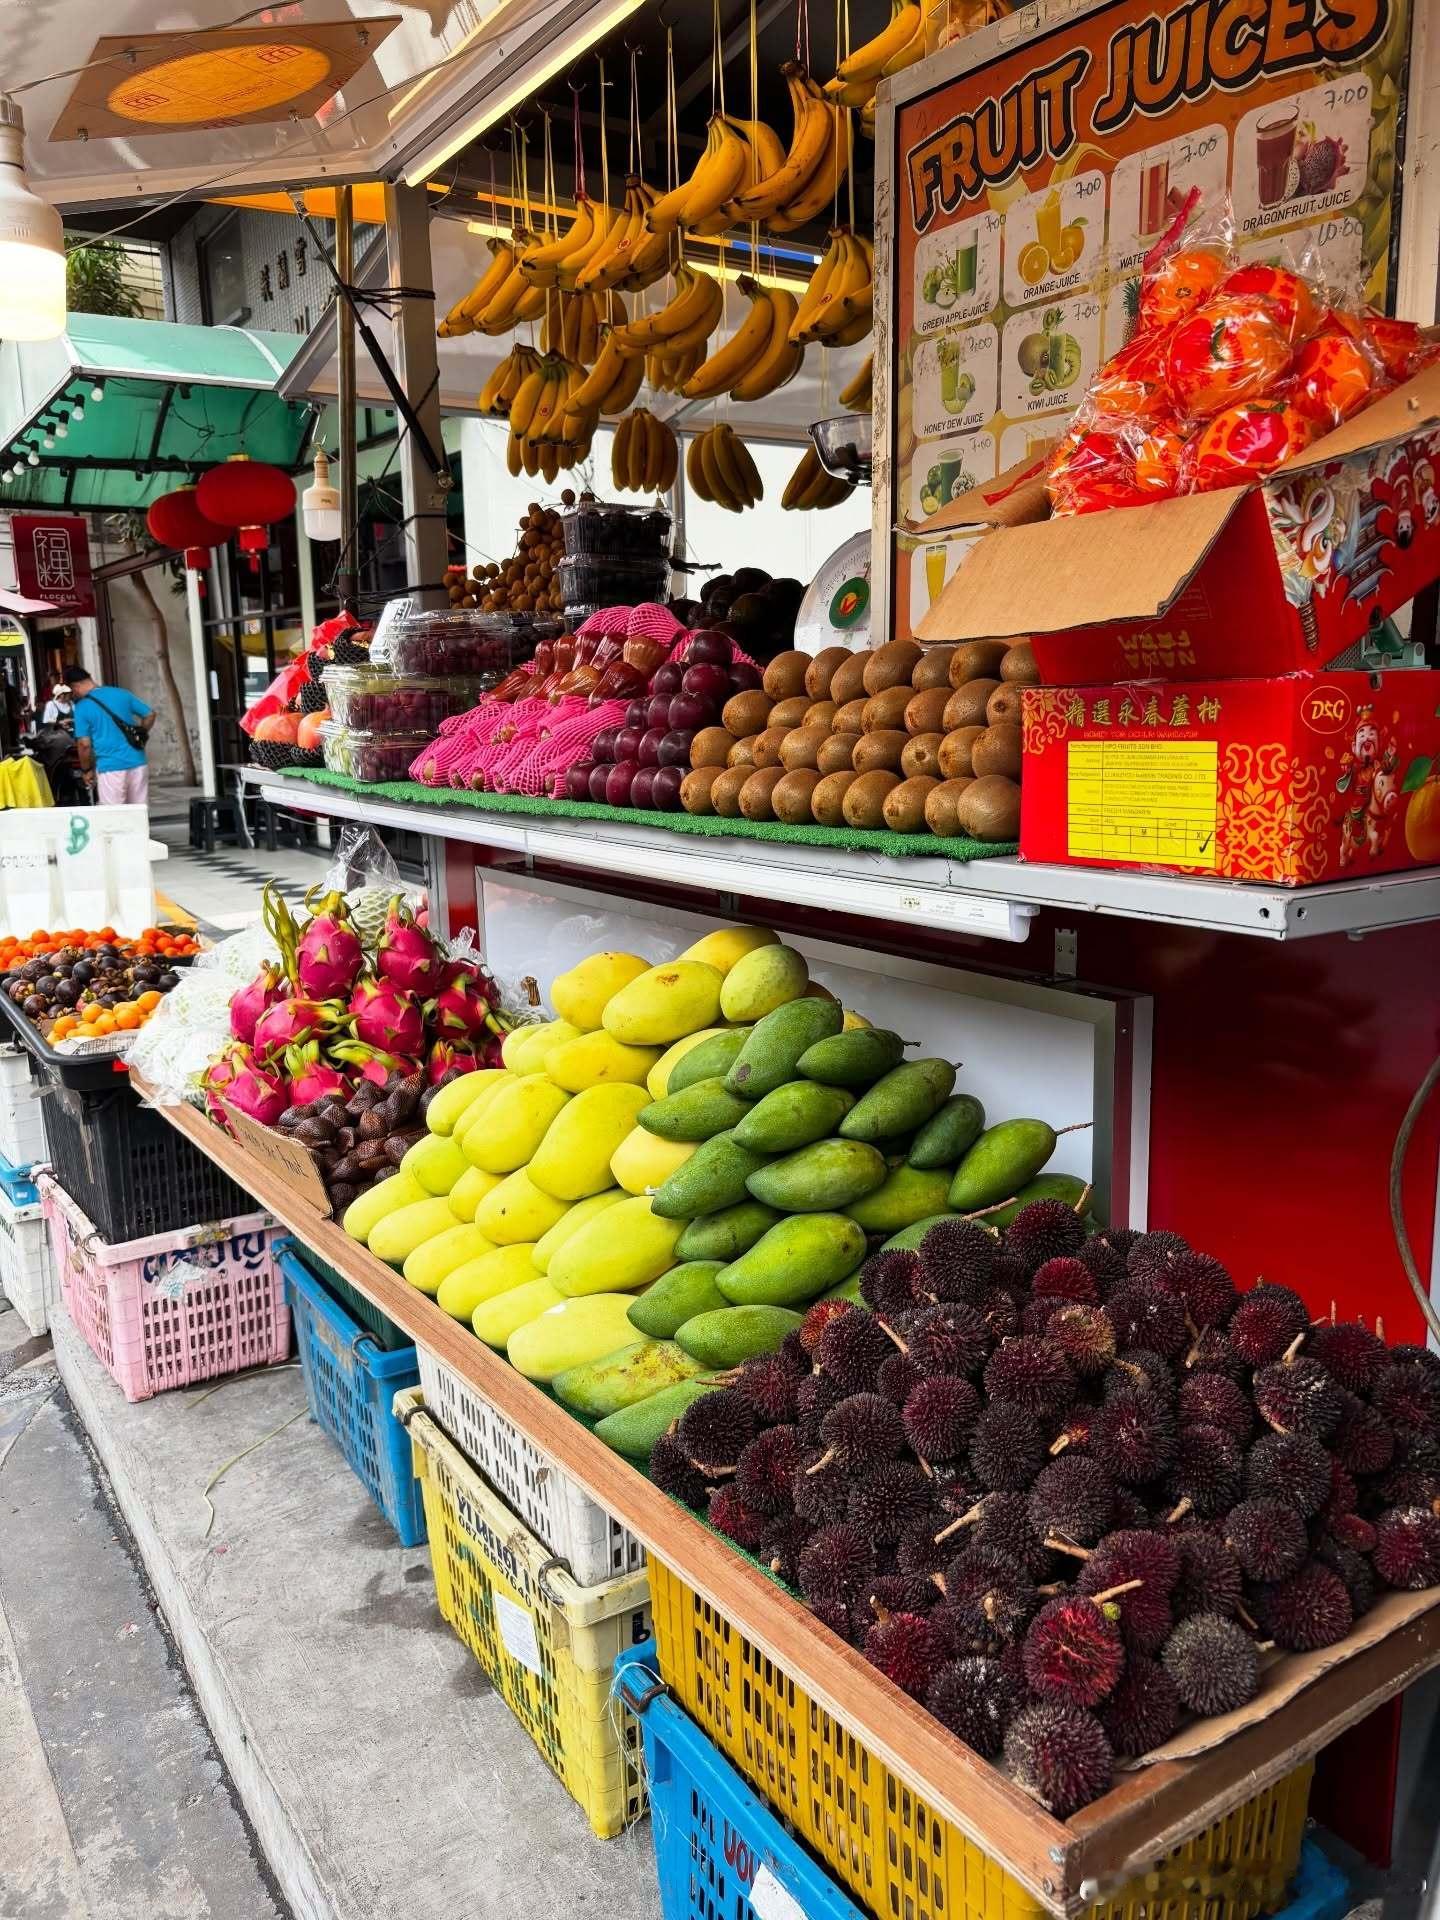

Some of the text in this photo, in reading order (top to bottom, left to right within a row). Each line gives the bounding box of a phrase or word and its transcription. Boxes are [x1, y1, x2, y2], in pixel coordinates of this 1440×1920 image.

[907, 0, 1390, 234] FRUIT JUICES
[1243, 190, 1352, 231] DRAGONFRUIT JUICE
[1023, 272, 1081, 300] ORANGE JUICE
[922, 301, 990, 331] GREEN APPLE JUICE
[1027, 392, 1069, 411] KIWI JUICE
[923, 412, 985, 435] HONEY DEW JUICE
